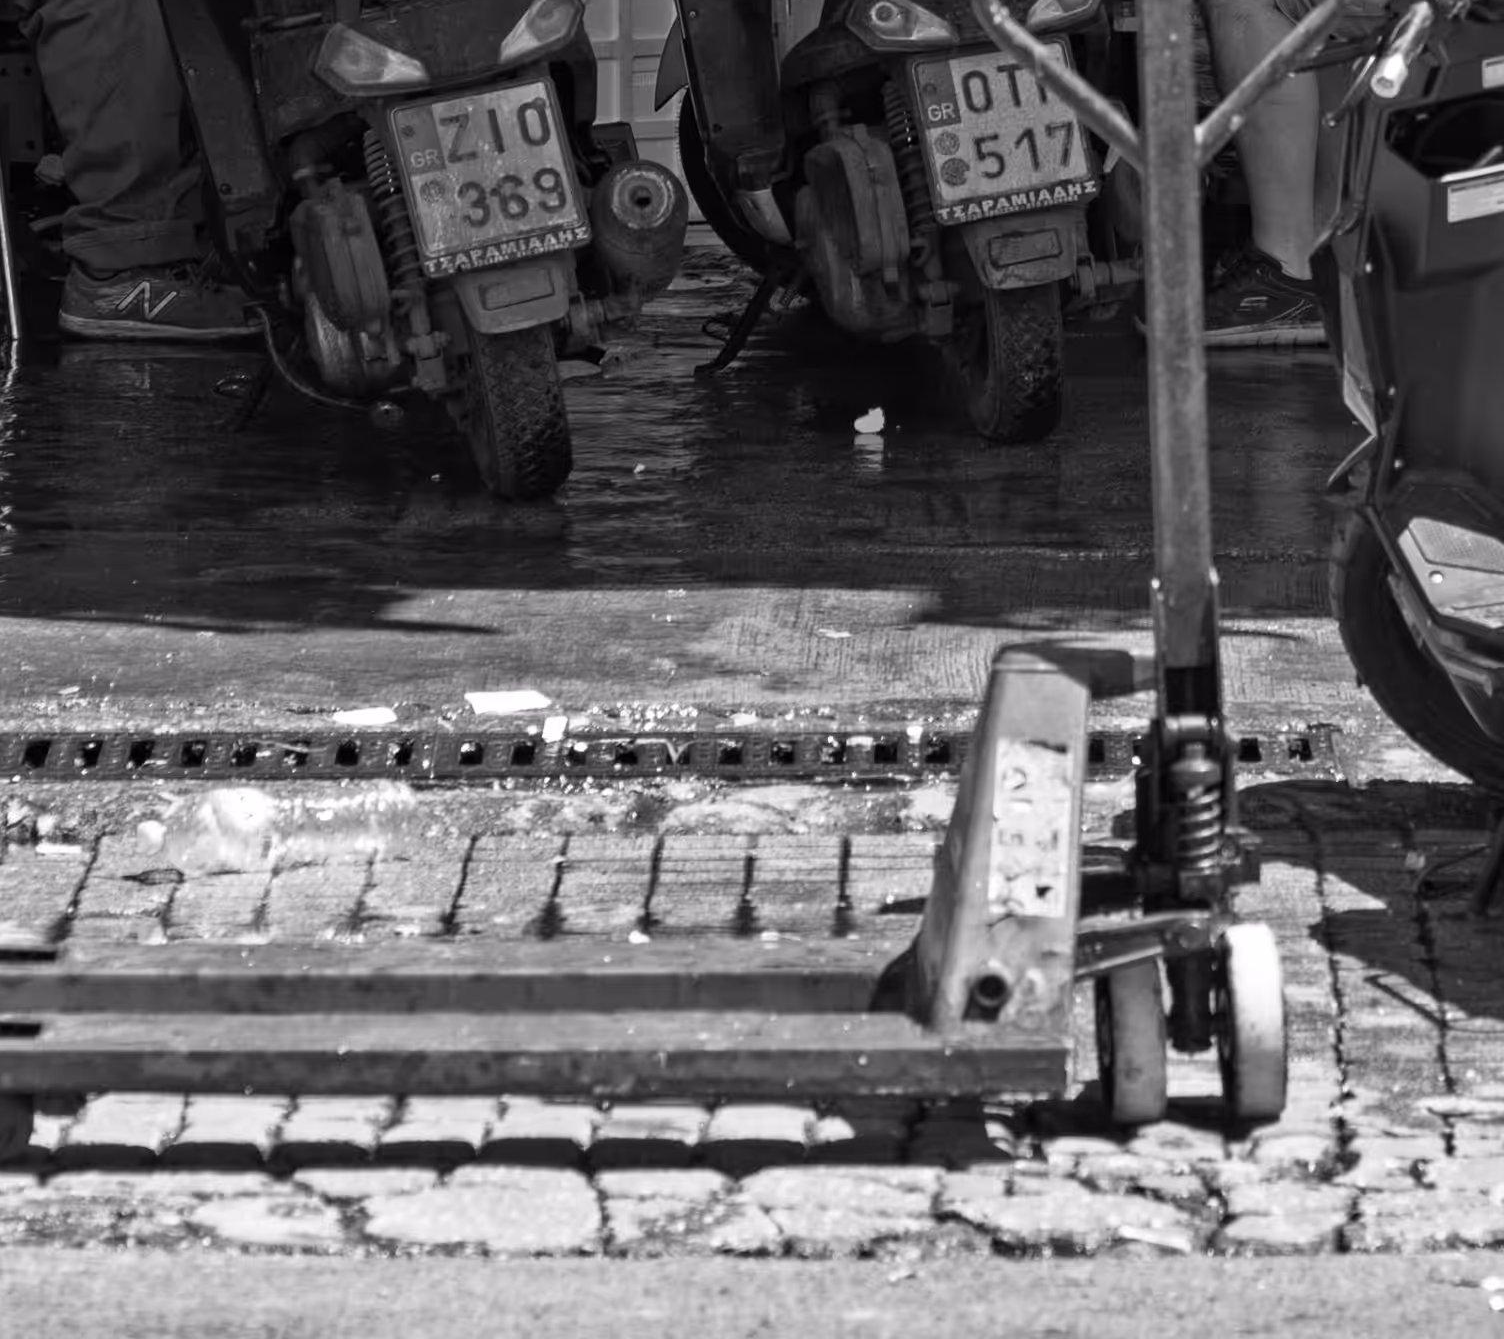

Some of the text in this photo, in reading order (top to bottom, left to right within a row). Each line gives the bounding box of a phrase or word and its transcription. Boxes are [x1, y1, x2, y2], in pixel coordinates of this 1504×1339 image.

[962, 64, 1047, 113] OT
[927, 103, 955, 122] GR
[410, 149, 439, 168] GR
[973, 121, 1073, 178] 517
[457, 167, 567, 227] 369
[937, 180, 1096, 220] ΤΣΑΡΑΜΙΑΔΗΣ
[424, 226, 589, 272] ΤΣΑΡΑΜΙΑΔΗΣ
